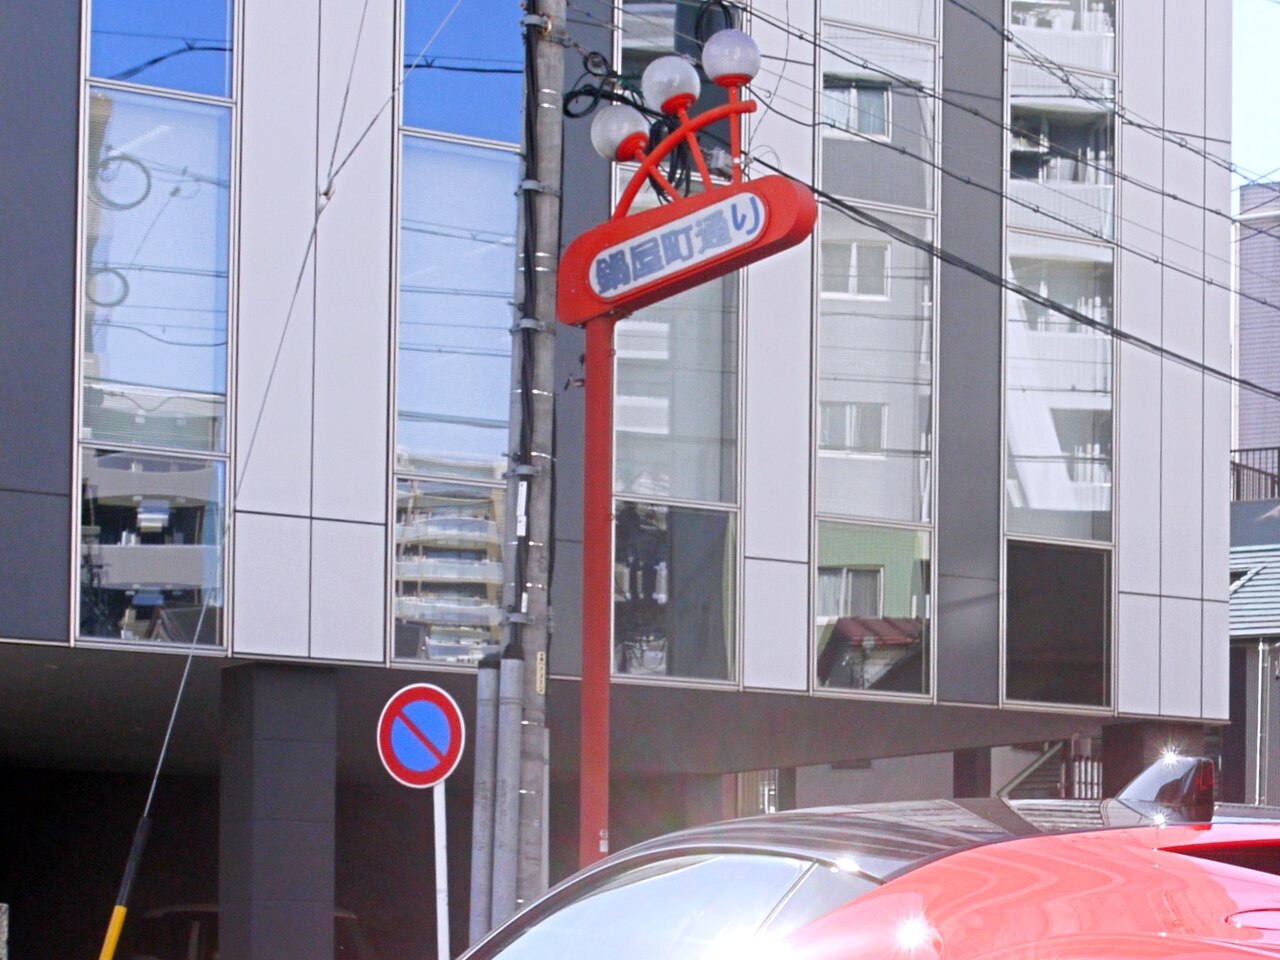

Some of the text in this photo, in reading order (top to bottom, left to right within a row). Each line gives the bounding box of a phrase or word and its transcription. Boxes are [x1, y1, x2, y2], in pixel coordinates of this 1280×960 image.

[595, 196, 760, 294] 鍋屋町通り
